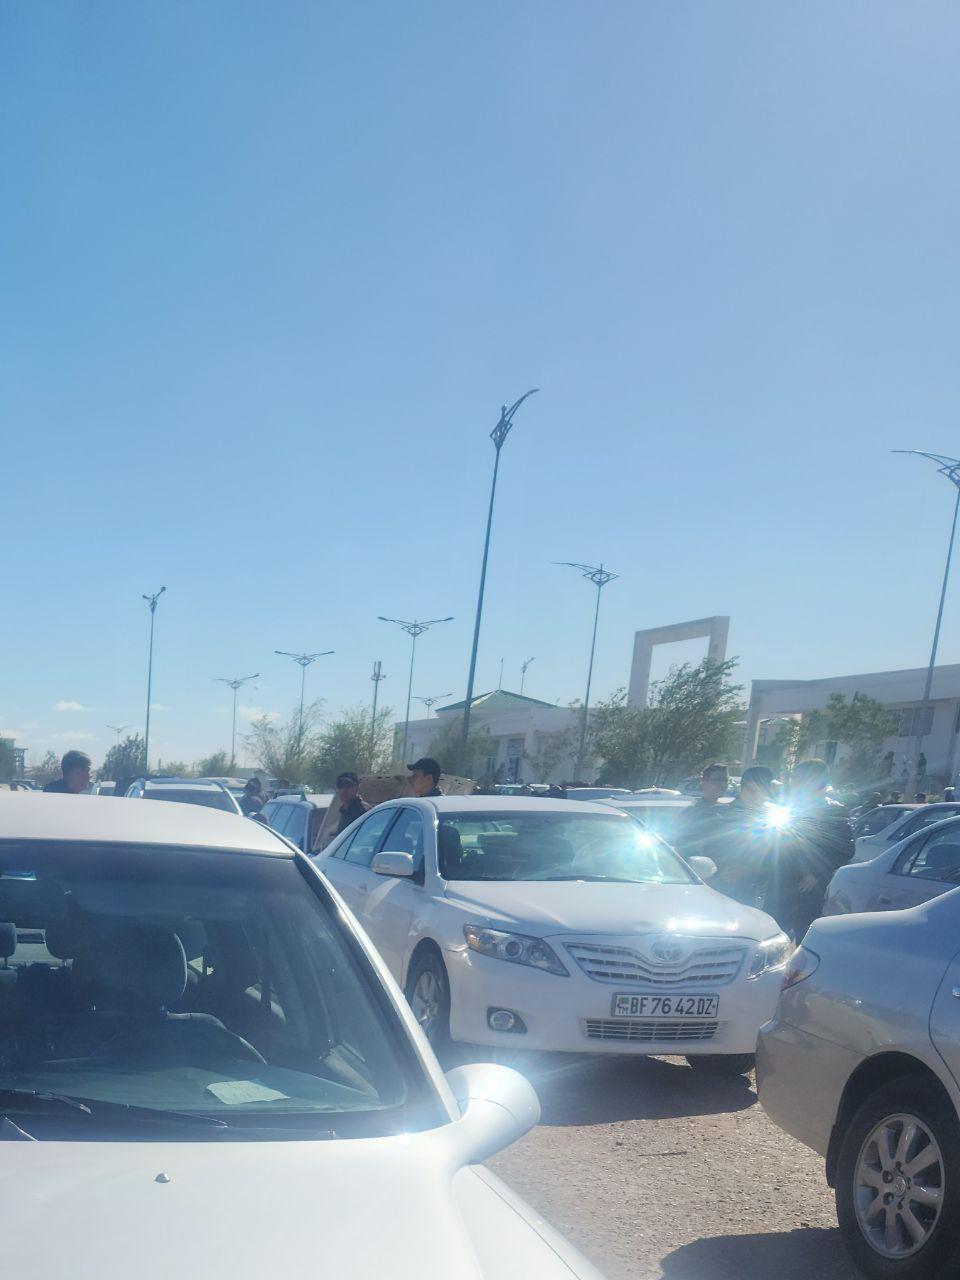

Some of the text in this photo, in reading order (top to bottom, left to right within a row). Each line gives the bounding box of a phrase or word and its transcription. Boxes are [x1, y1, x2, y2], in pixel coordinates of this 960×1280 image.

[630, 997, 714, 1015] BF 76 42 DZ
